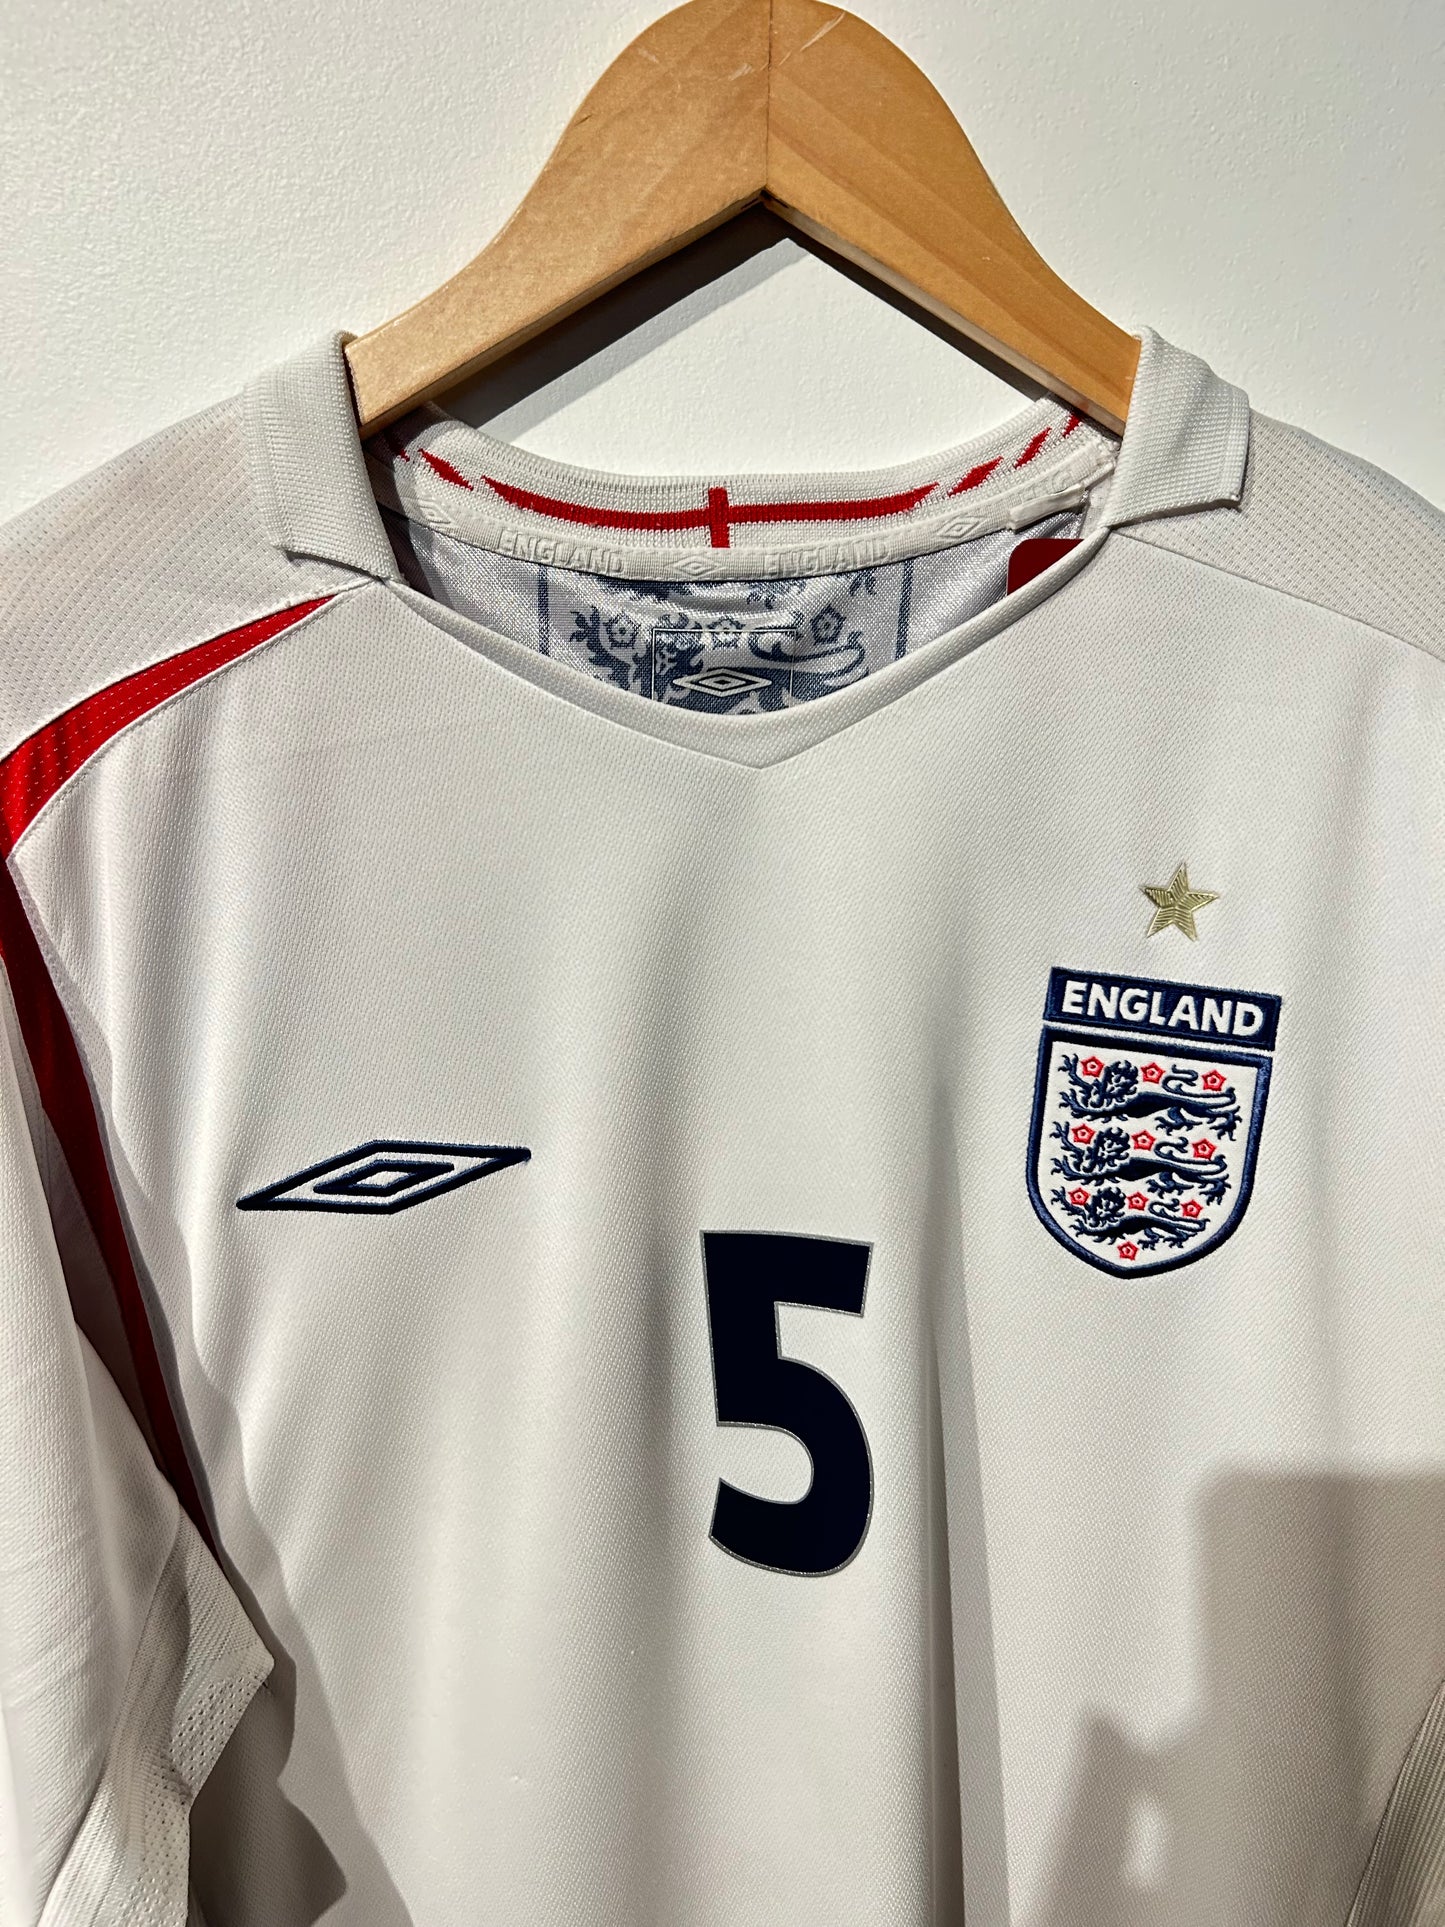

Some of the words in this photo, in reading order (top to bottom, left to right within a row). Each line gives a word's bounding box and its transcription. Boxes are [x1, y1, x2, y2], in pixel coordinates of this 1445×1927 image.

[498, 526, 625, 575] ENGLAND
[764, 537, 889, 578] ENGLAND
[1061, 980, 1264, 1037] ENGLAND
[700, 1229, 875, 1578] 5
